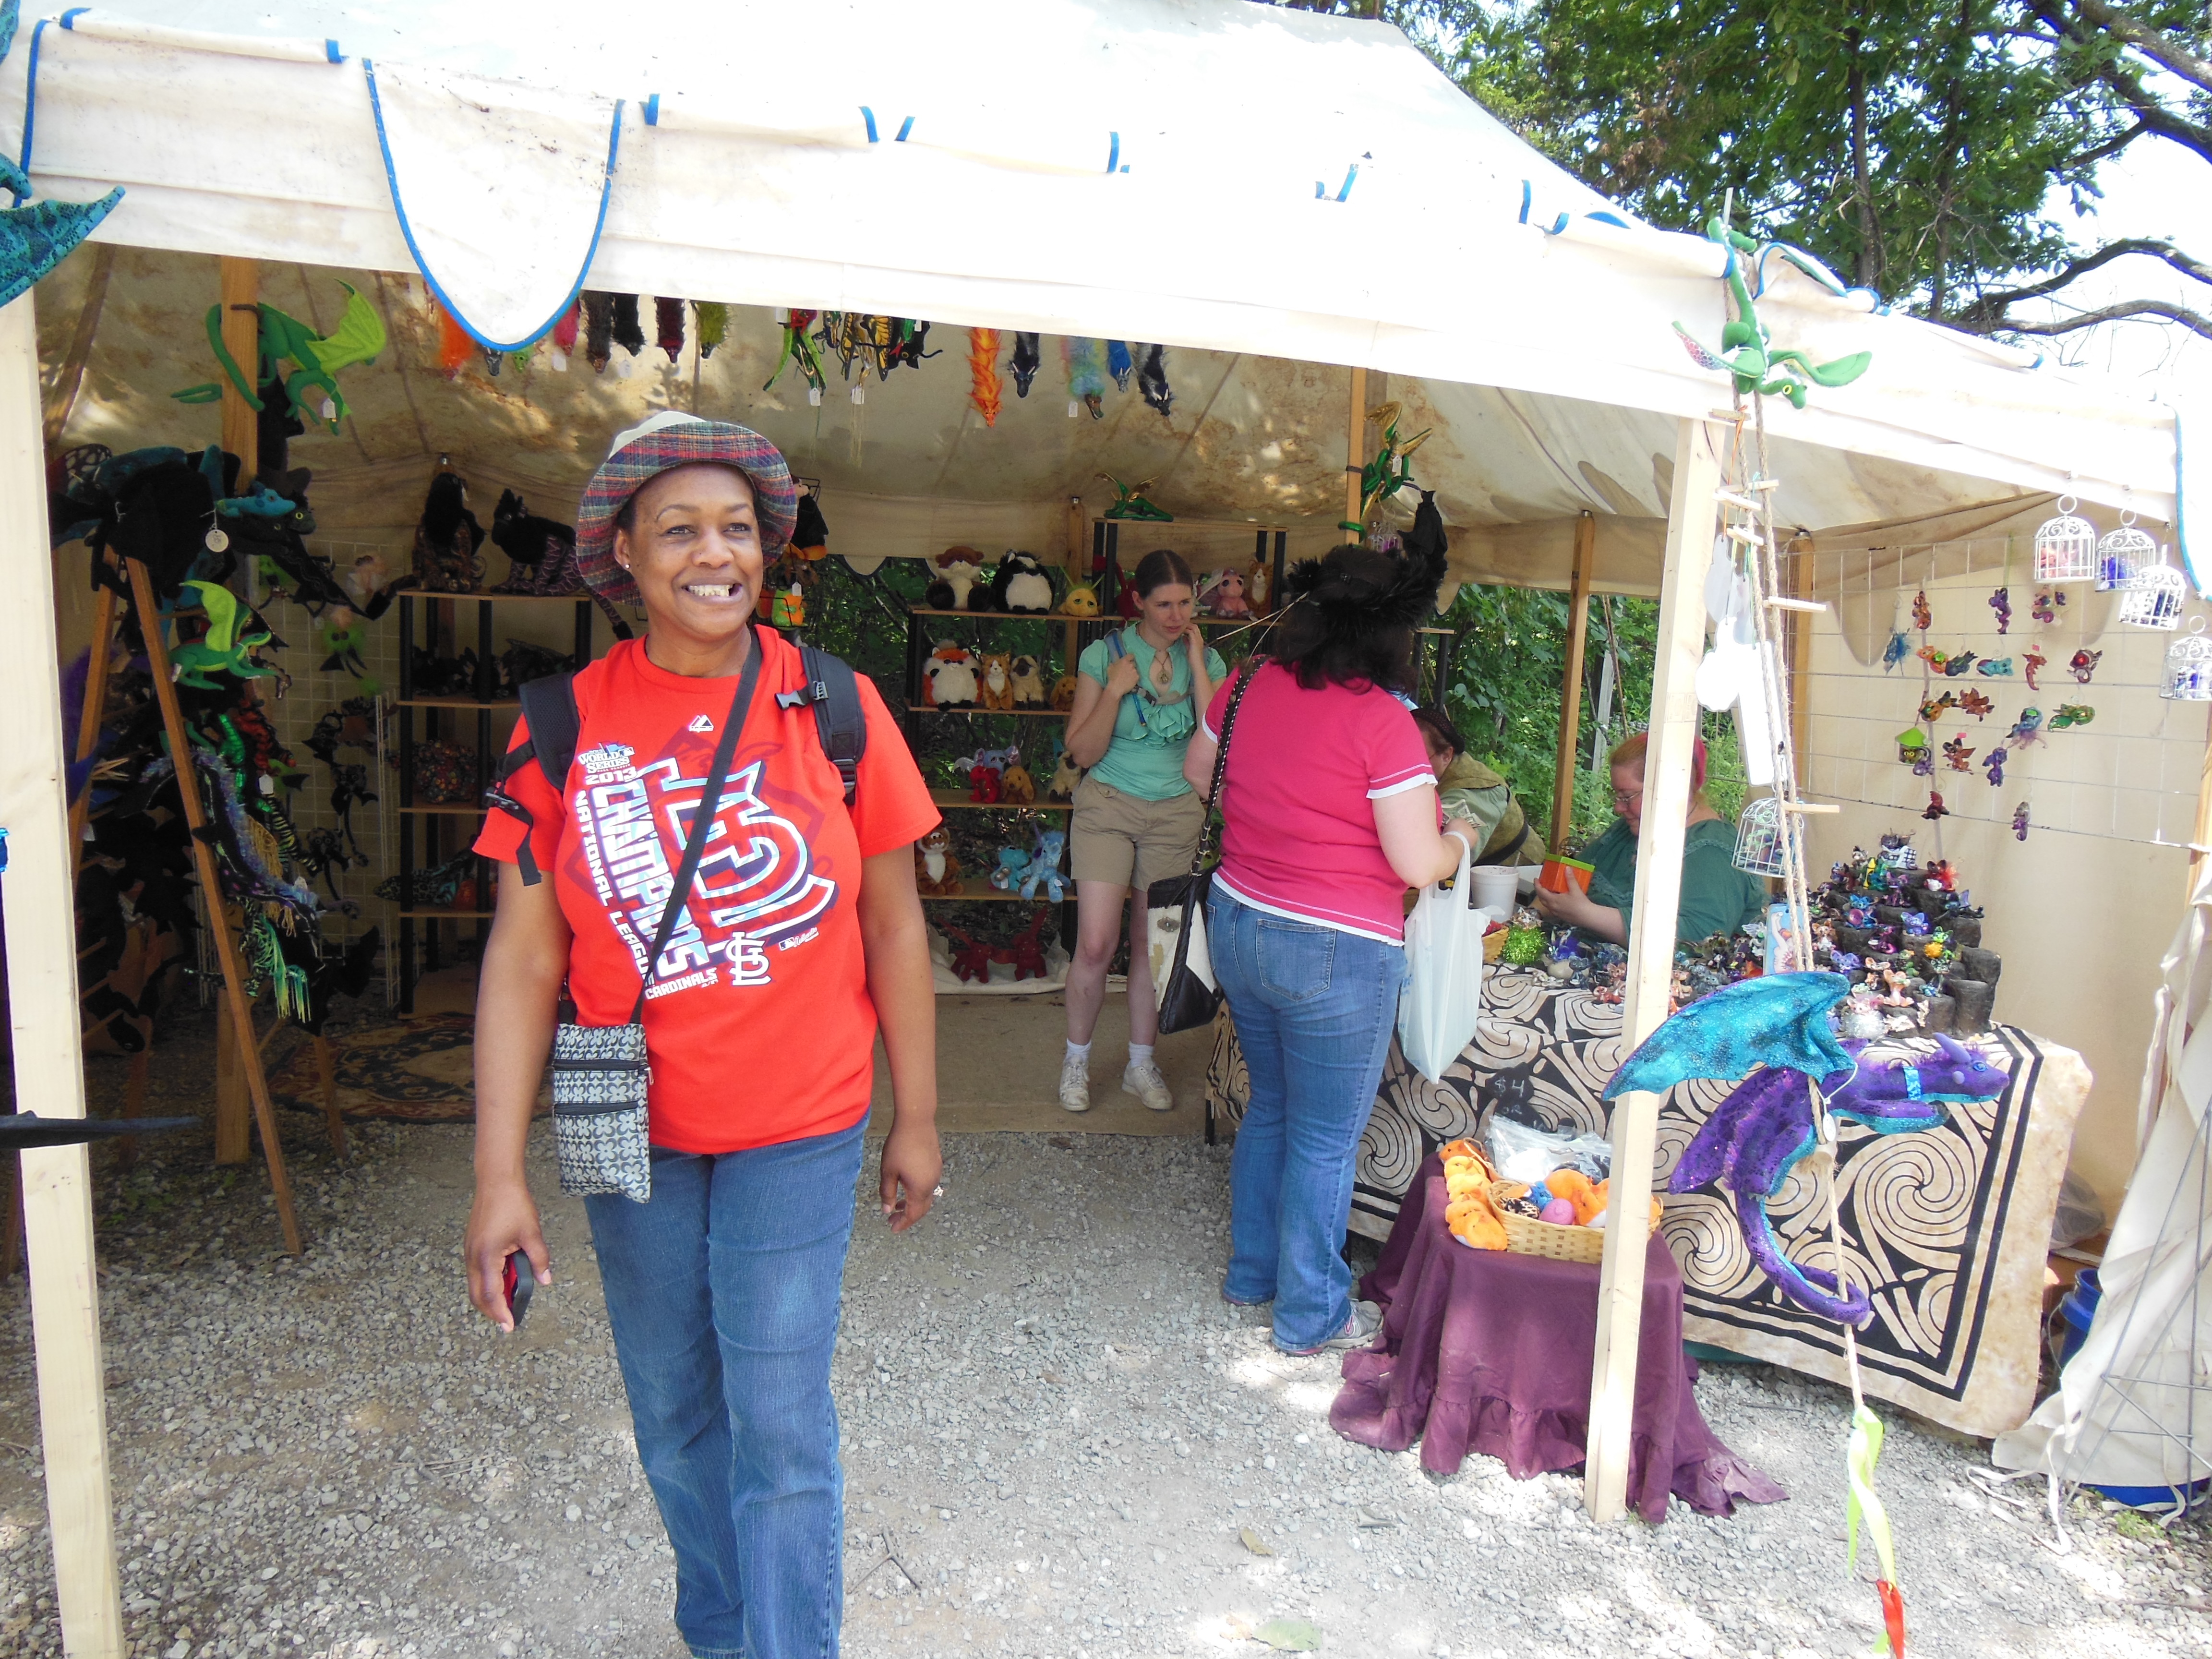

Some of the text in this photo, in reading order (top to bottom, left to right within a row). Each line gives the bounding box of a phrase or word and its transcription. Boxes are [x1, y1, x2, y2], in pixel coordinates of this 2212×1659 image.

[578, 751, 620, 765] WORLD
[586, 757, 630, 774] SERIES
[585, 766, 638, 785] 2013
[575, 790, 614, 907] NATIONAL
[645, 967, 718, 999] CARDINALS
